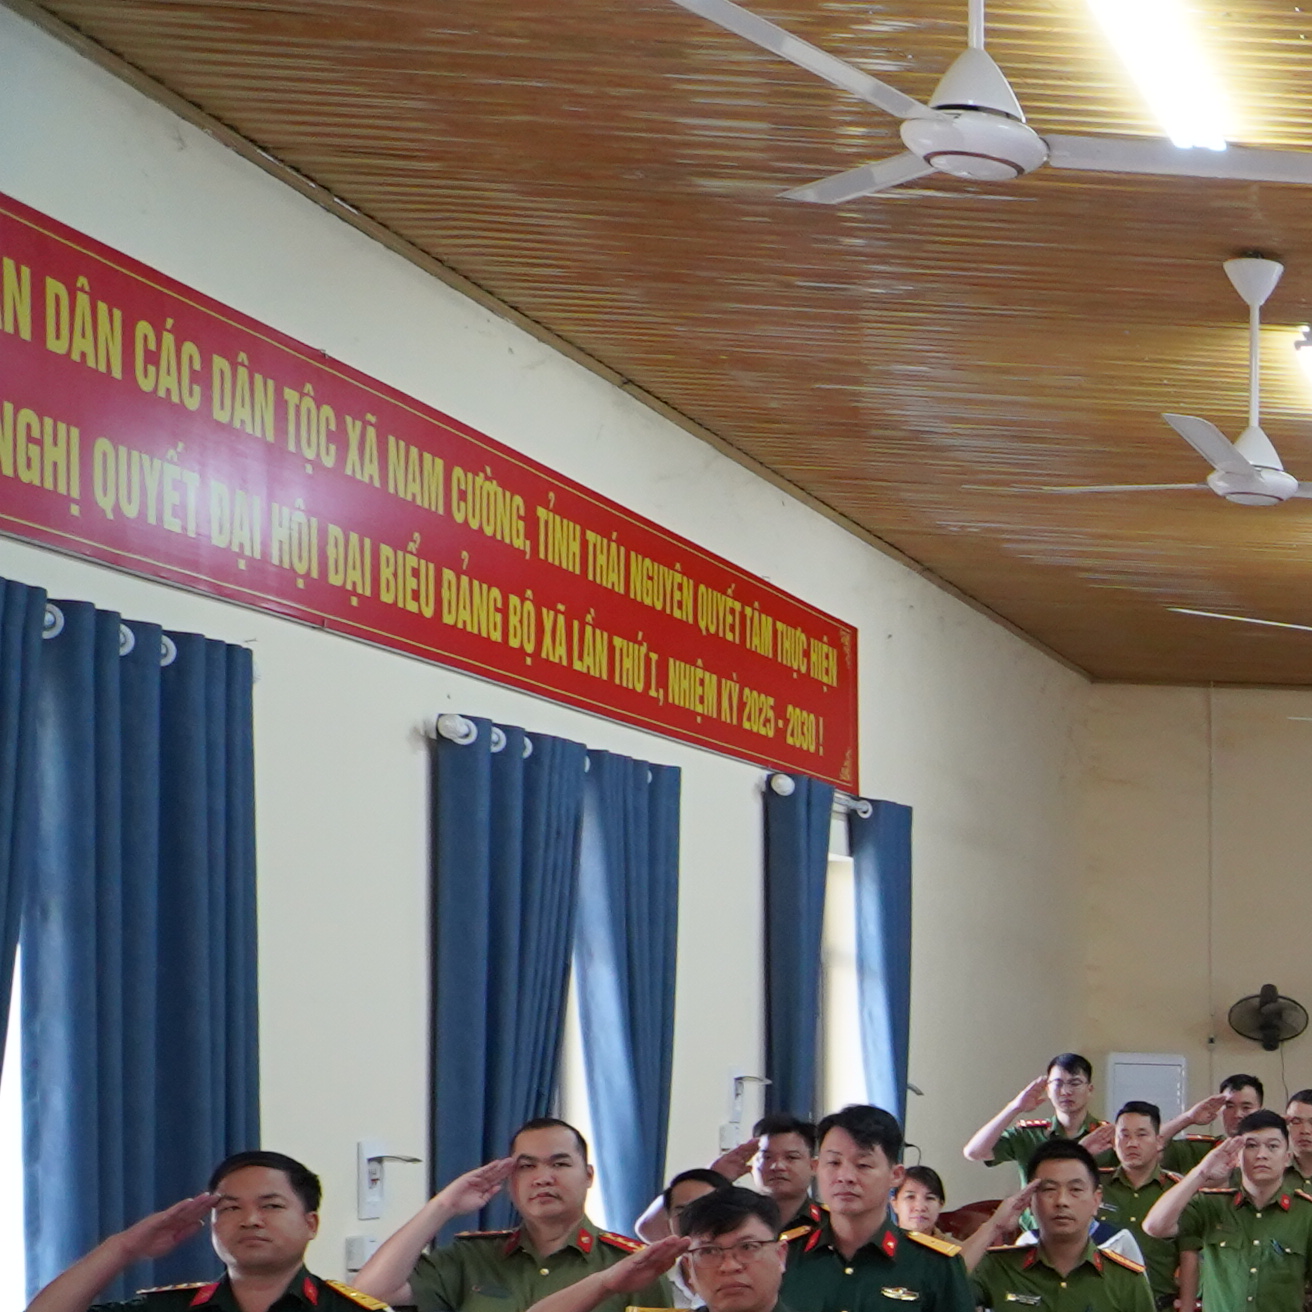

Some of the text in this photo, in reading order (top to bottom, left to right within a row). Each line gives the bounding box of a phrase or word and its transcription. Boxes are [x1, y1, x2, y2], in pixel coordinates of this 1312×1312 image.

[0, 257, 838, 692] N DÂN CÁC DÂN TỘC XÃ NAM CƯỜNG, TỈNH THÁI NGUYÊN QUYẾT TÂM THỰC HIỆN
[93, 437, 199, 539] QUYẾT
[209, 479, 261, 570] ĐẠI
[271, 498, 319, 589] HỘI
[326, 523, 371, 607] ĐẠI
[380, 532, 434, 618] BIỂU
[441, 551, 502, 643] ĐẢNG
[508, 589, 535, 665] BỘ
[541, 603, 567, 667] XÃ
[573, 607, 608, 680] LẦN
[613, 631, 648, 693] THỨ
[649, 652, 664, 704] I,
[668, 658, 717, 723] NHIỆM
[721, 672, 739, 727] KỲ
[743, 687, 775, 738] 2025
[786, 704, 815, 753] 2030
